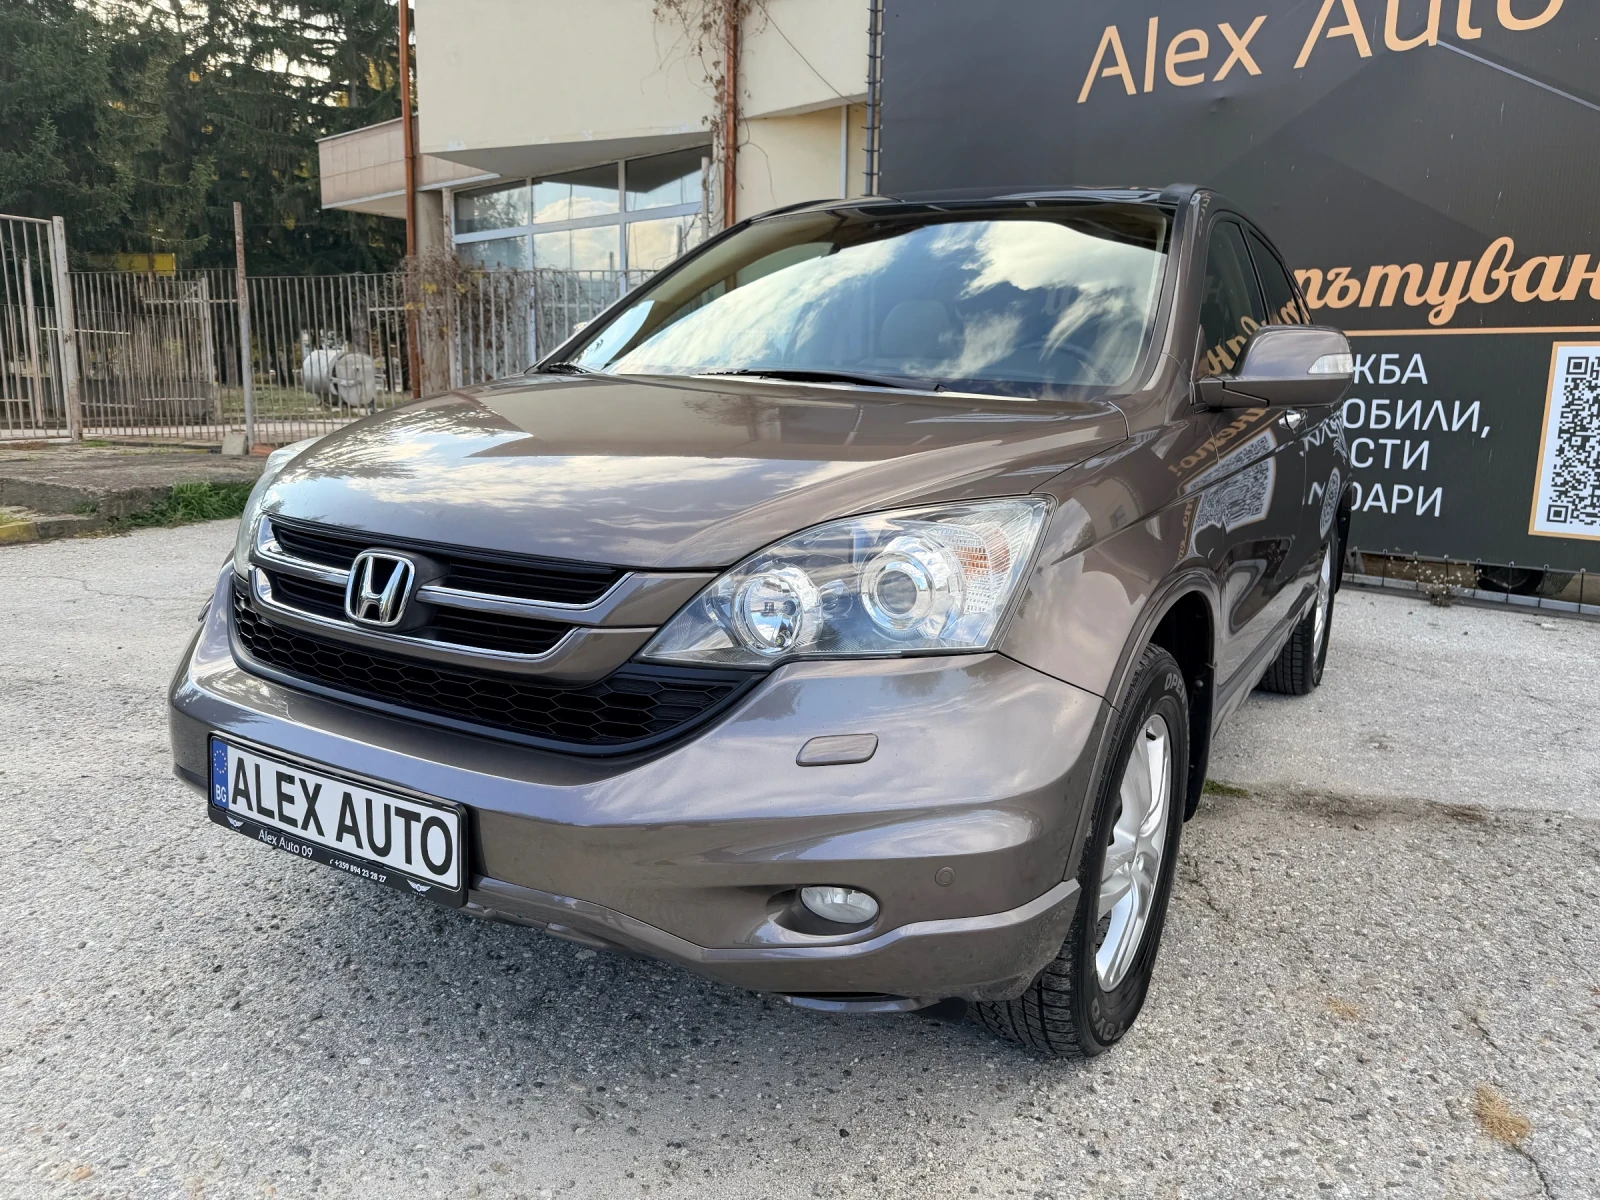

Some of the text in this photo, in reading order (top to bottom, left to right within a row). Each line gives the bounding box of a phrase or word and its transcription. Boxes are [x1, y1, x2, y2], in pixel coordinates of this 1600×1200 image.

[1077, 15, 1267, 104] Alex
[1342, 398, 1491, 439] ОБИЛИ,
[1350, 437, 1430, 471] СТИ
[215, 784, 227, 803] BG
[231, 756, 453, 877] ALEX AUTO
[258, 829, 278, 846] Alex
[279, 837, 300, 854] Auto
[301, 845, 313, 858] 09
